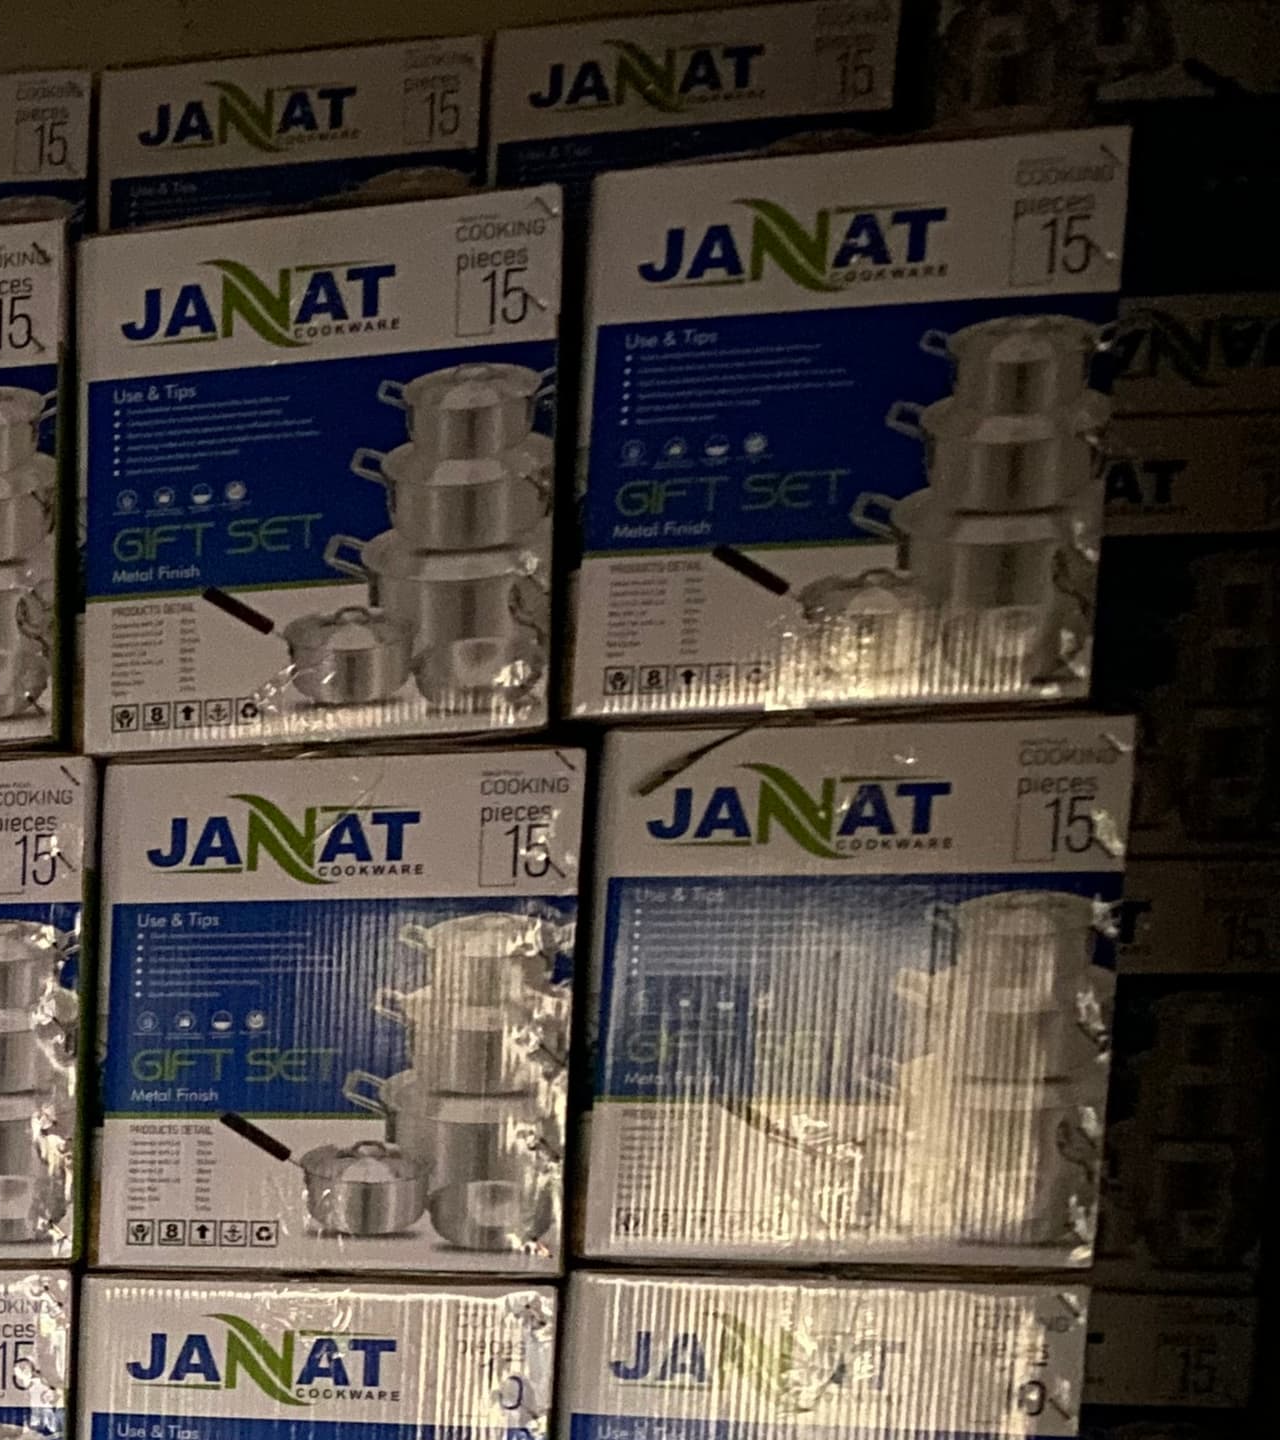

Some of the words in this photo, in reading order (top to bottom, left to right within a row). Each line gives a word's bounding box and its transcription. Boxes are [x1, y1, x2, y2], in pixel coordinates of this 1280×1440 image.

[526, 42, 765, 112] JANAT
[136, 82, 357, 153] JANAT
[455, 216, 546, 244] COOKING
[456, 244, 528, 273] pieces
[638, 199, 947, 292] JANAT
[1036, 213, 1094, 275] 15
[122, 260, 396, 347] JANAT
[480, 266, 529, 326] 15
[147, 794, 421, 885] JANAT
[646, 763, 952, 859] JANAT
[835, 837, 954, 852] COOKWARE
[318, 864, 424, 879] COOKWARE
[127, 1313, 396, 1405] JANAT
